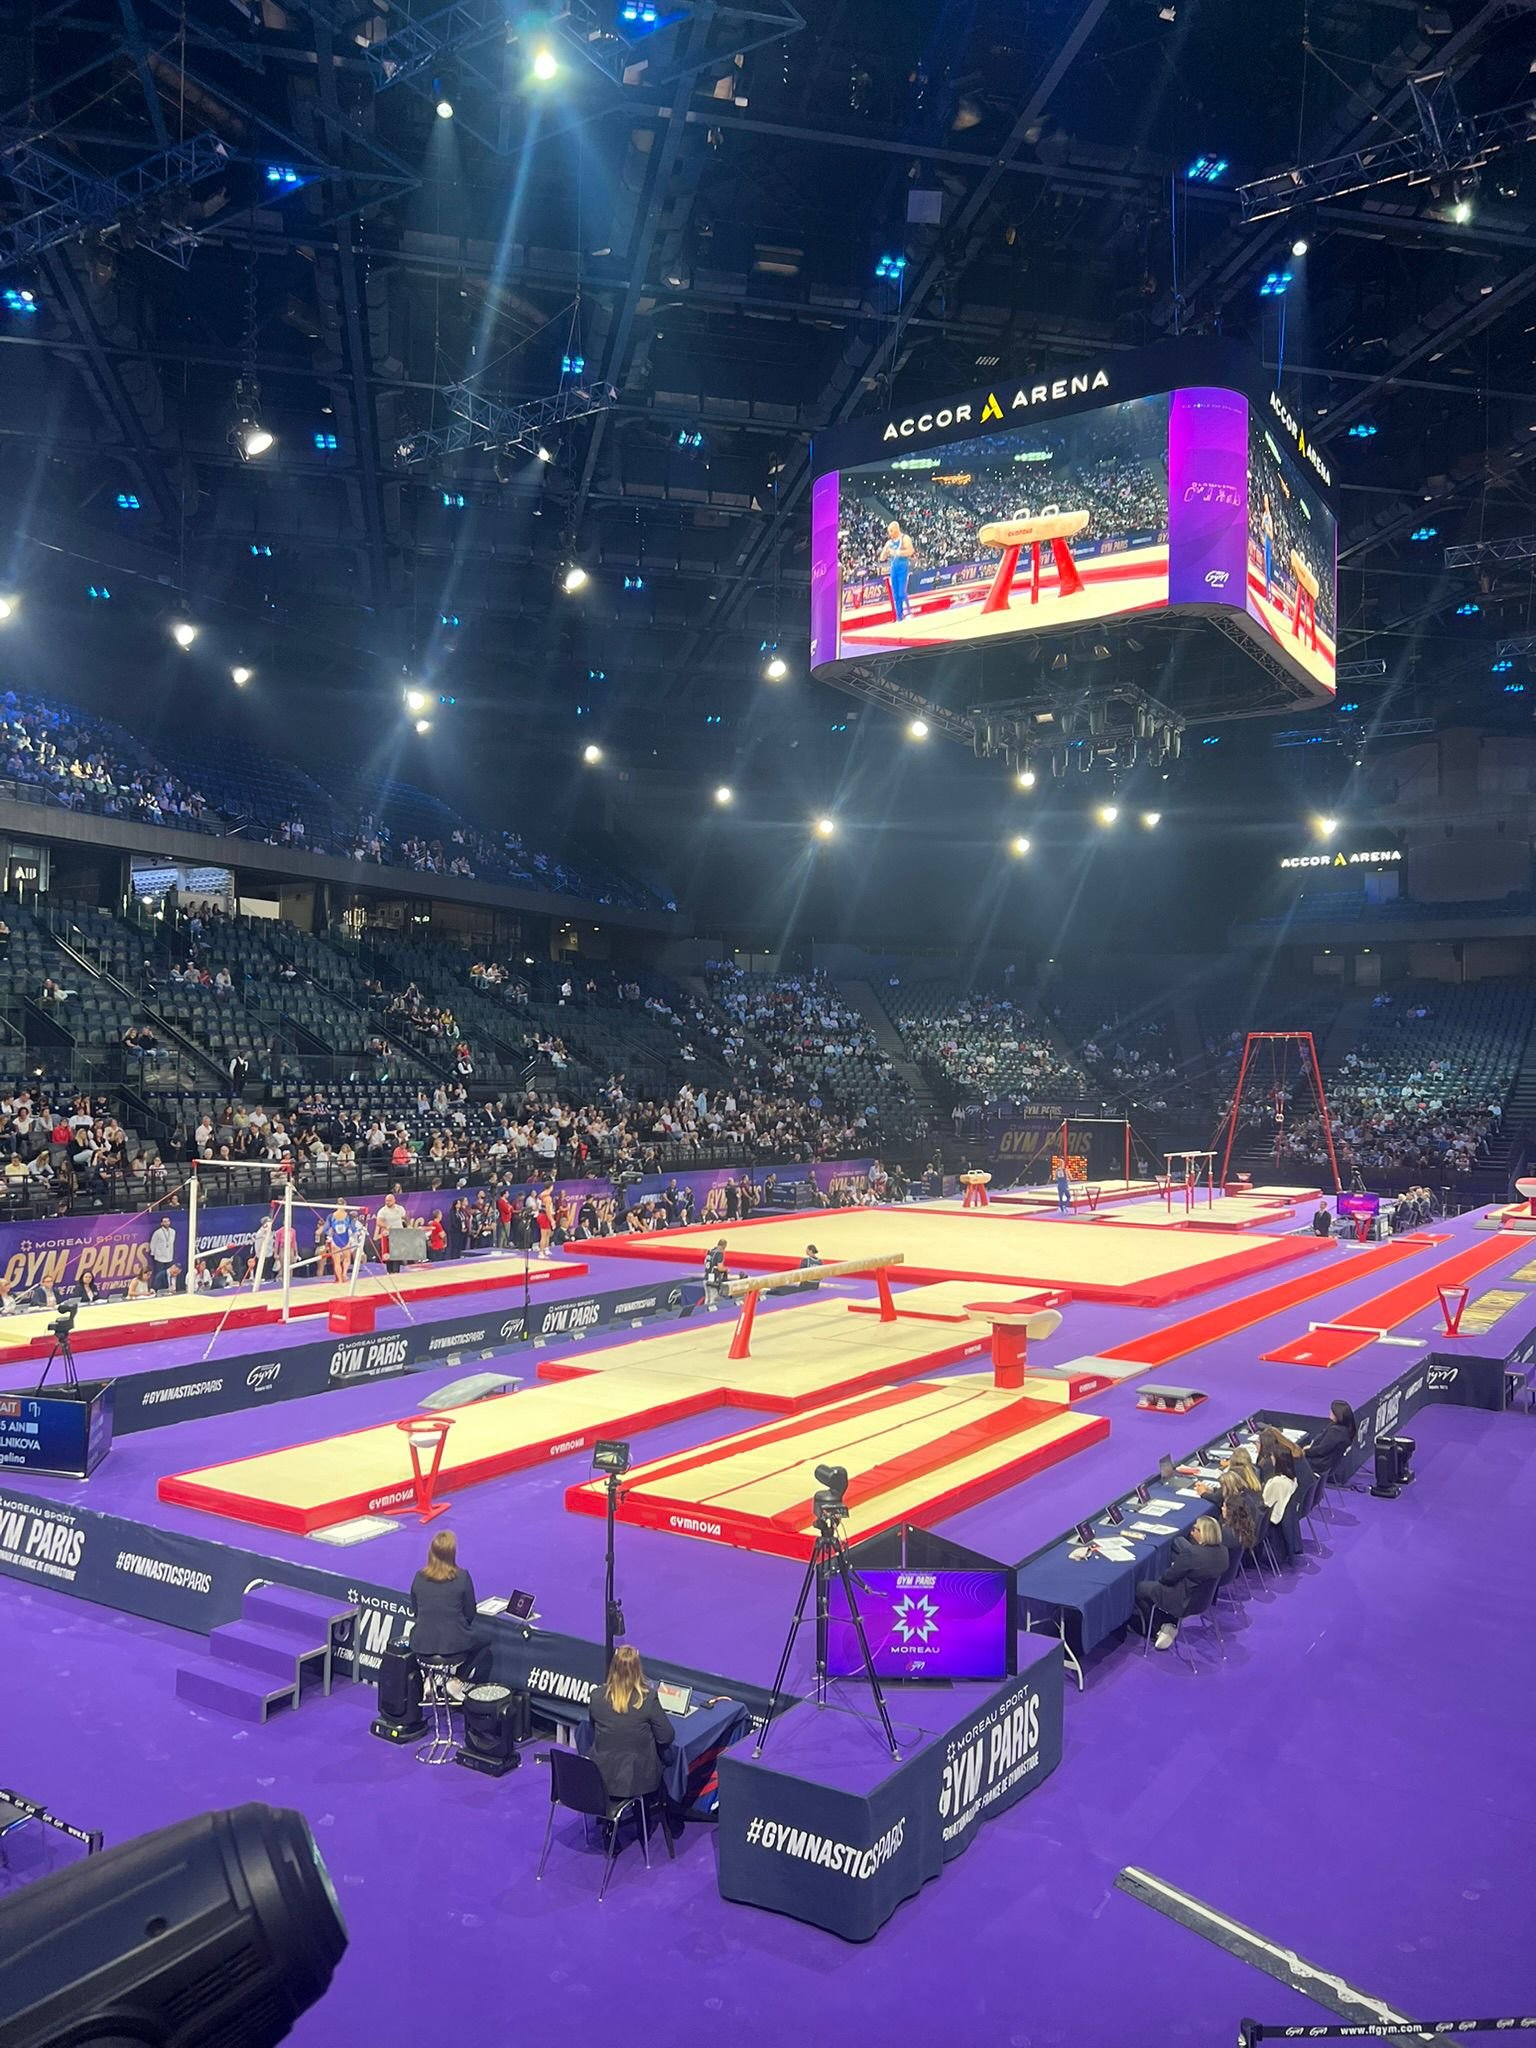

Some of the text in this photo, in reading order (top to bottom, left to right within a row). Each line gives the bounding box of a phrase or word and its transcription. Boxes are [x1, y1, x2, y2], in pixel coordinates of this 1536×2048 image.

[883, 404, 971, 441] ACCOR
[1011, 370, 1110, 409] ARENA
[1269, 390, 1298, 439] ACCOR
[1306, 443, 1331, 487] ARENA
[1281, 855, 1330, 868] ACCOR
[1350, 850, 1401, 863] ARENA
[1001, 1131, 1040, 1152] GYM
[36, 1233, 138, 1249] MOREAU SPORT
[3, 1249, 70, 1288] GYM
[75, 1242, 150, 1281] PARIS
[541, 1304, 600, 1334] GYM PARIS
[329, 1346, 365, 1376] GYM
[366, 1339, 409, 1369] PARIS
[346, 1338, 376, 1350] MOREAU
[142, 1378, 223, 1406] #GYMNASTICSPARIS
[0, 1401, 18, 1413] AIT
[0, 1436, 41, 1451] LNIKOVA
[369, 1487, 414, 1510] GYMNOVA
[3, 1500, 76, 1526] MOREAU SPORT
[670, 1515, 721, 1536] GYMNOVA
[0, 1508, 86, 1567] YM PARIS
[115, 1551, 212, 1594] #GYMNASTICSPARIS
[896, 1575, 937, 1586] GYM PARIS
[891, 1646, 940, 1654] MOREAU
[956, 1683, 1029, 1751] MOREAU SPORT
[938, 1693, 1040, 1820] GYM PARIS
[980, 1780, 1002, 1810] FRANCE
[1001, 1774, 1009, 1794] DE
[1008, 1750, 1040, 1788] GYMNASTIQUE
[746, 1816, 906, 1880] #GYMNASTICSPARIS
[1340, 2023, 1423, 2036] www.ffgym.com
